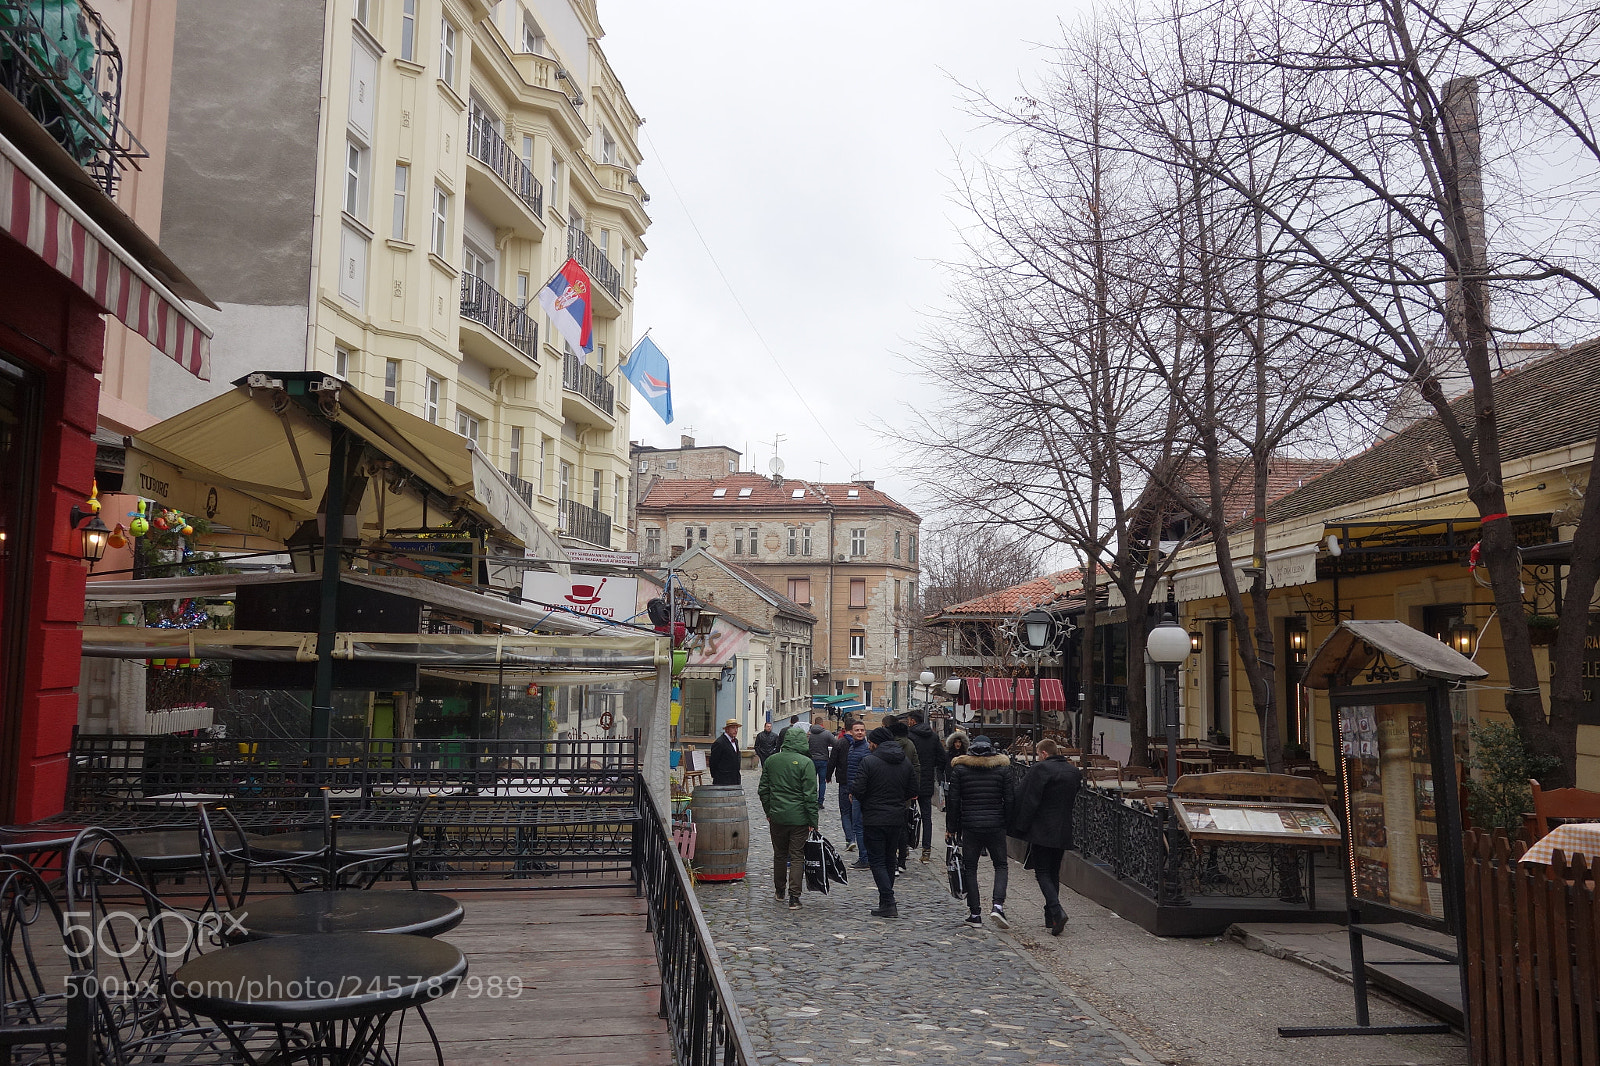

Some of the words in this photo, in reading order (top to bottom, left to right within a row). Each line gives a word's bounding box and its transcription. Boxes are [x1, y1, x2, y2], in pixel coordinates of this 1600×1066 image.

[139, 472, 169, 498] TUBORG
[251, 514, 271, 533] TUBORG
[726, 673, 736, 683] 27
